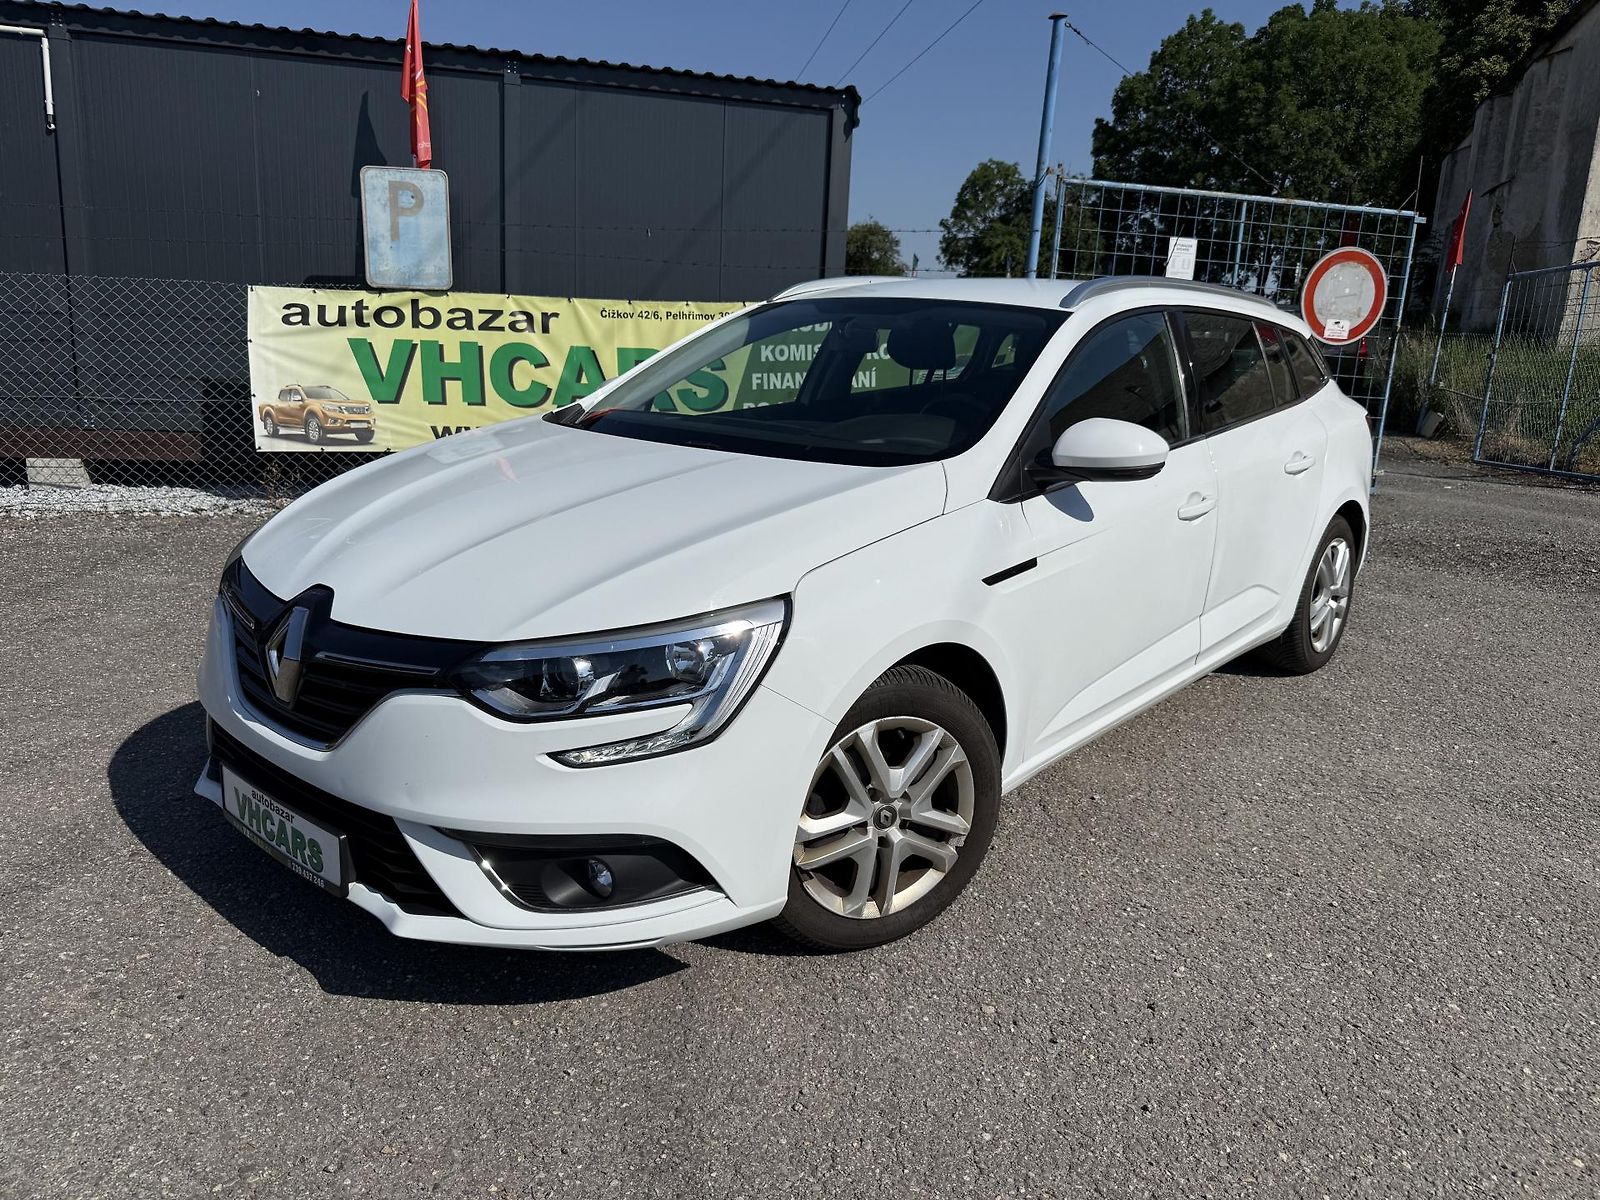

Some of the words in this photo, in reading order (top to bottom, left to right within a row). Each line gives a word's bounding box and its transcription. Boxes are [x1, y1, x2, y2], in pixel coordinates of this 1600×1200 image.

[388, 180, 424, 241] P
[281, 298, 560, 334] autobazar
[637, 310, 663, 322] 42/6,
[665, 311, 715, 322] Pelhřimov
[251, 789, 295, 824] autobazar
[234, 786, 324, 874] VHCARS
